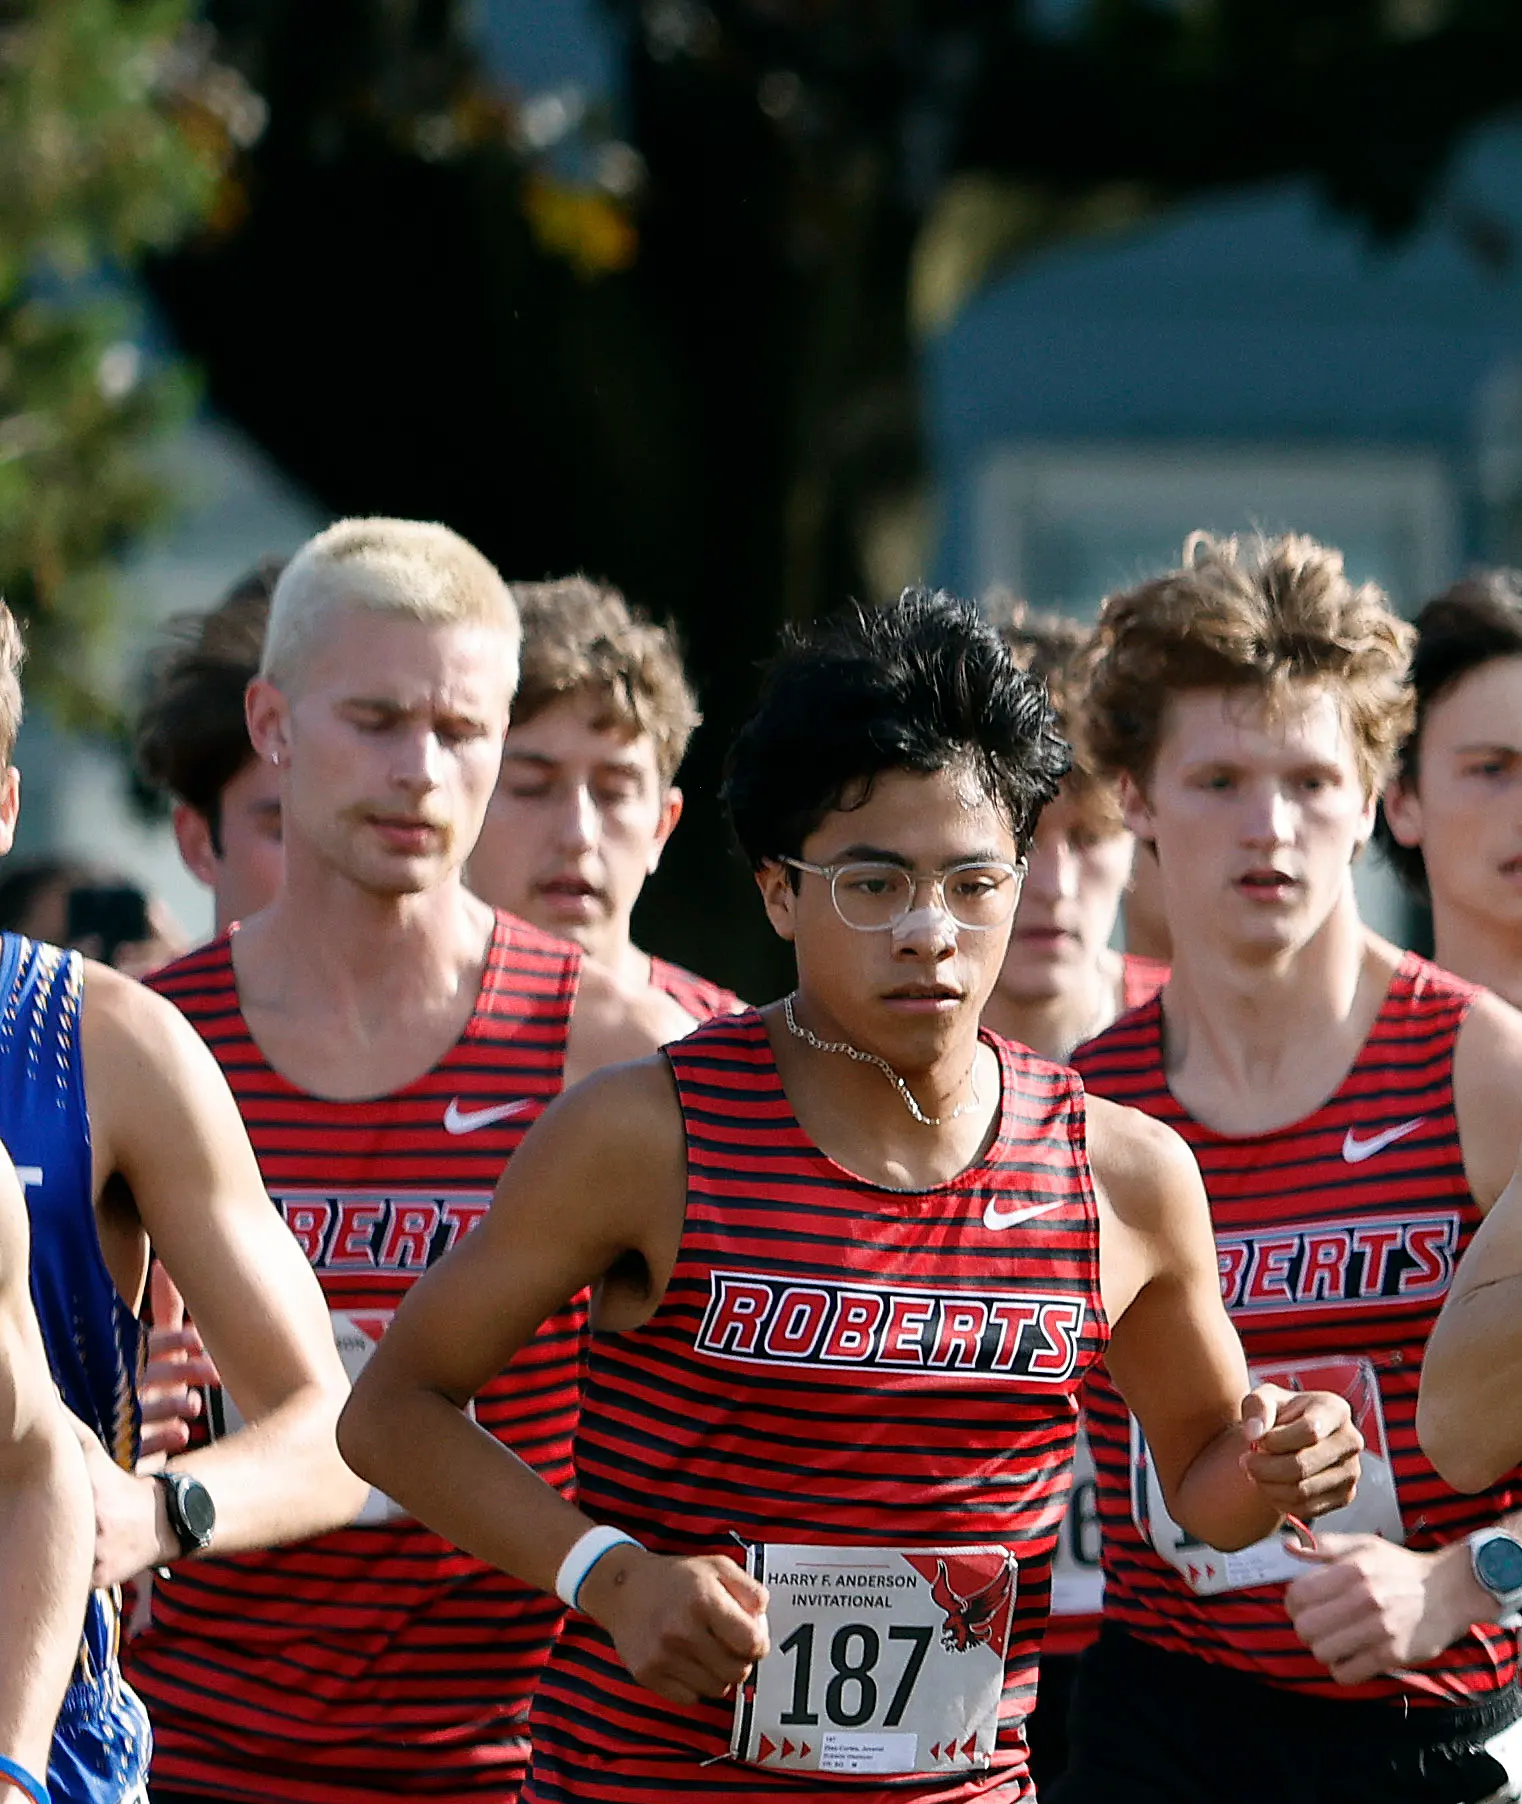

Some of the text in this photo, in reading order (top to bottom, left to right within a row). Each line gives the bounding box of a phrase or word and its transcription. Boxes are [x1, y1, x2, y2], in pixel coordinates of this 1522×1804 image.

[283, 1198, 492, 1268] BERT
[1216, 1222, 1452, 1306] BERTS
[704, 1279, 1083, 1375] ROBERTS
[768, 1572, 918, 1589] HARRY F. ANDERSON
[792, 1594, 893, 1609] INVITATIONAL
[779, 1622, 935, 1728] 187
